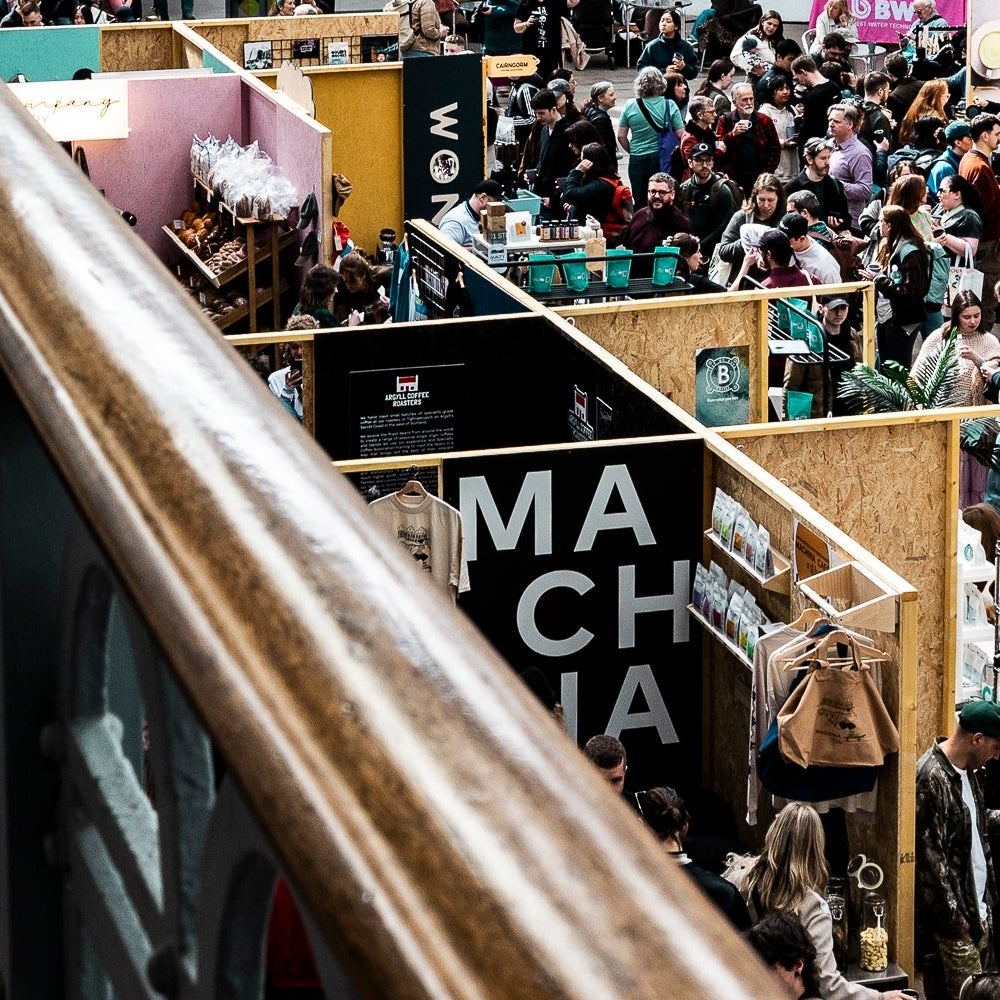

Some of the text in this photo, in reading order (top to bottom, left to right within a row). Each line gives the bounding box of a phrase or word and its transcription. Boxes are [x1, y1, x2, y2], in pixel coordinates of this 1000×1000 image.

[875, 0, 914, 21] BW
[385, 393, 406, 401] ARGYLL
[393, 399, 422, 407] ROASTERS
[459, 463, 657, 562] MA
[516, 560, 691, 657] CH
